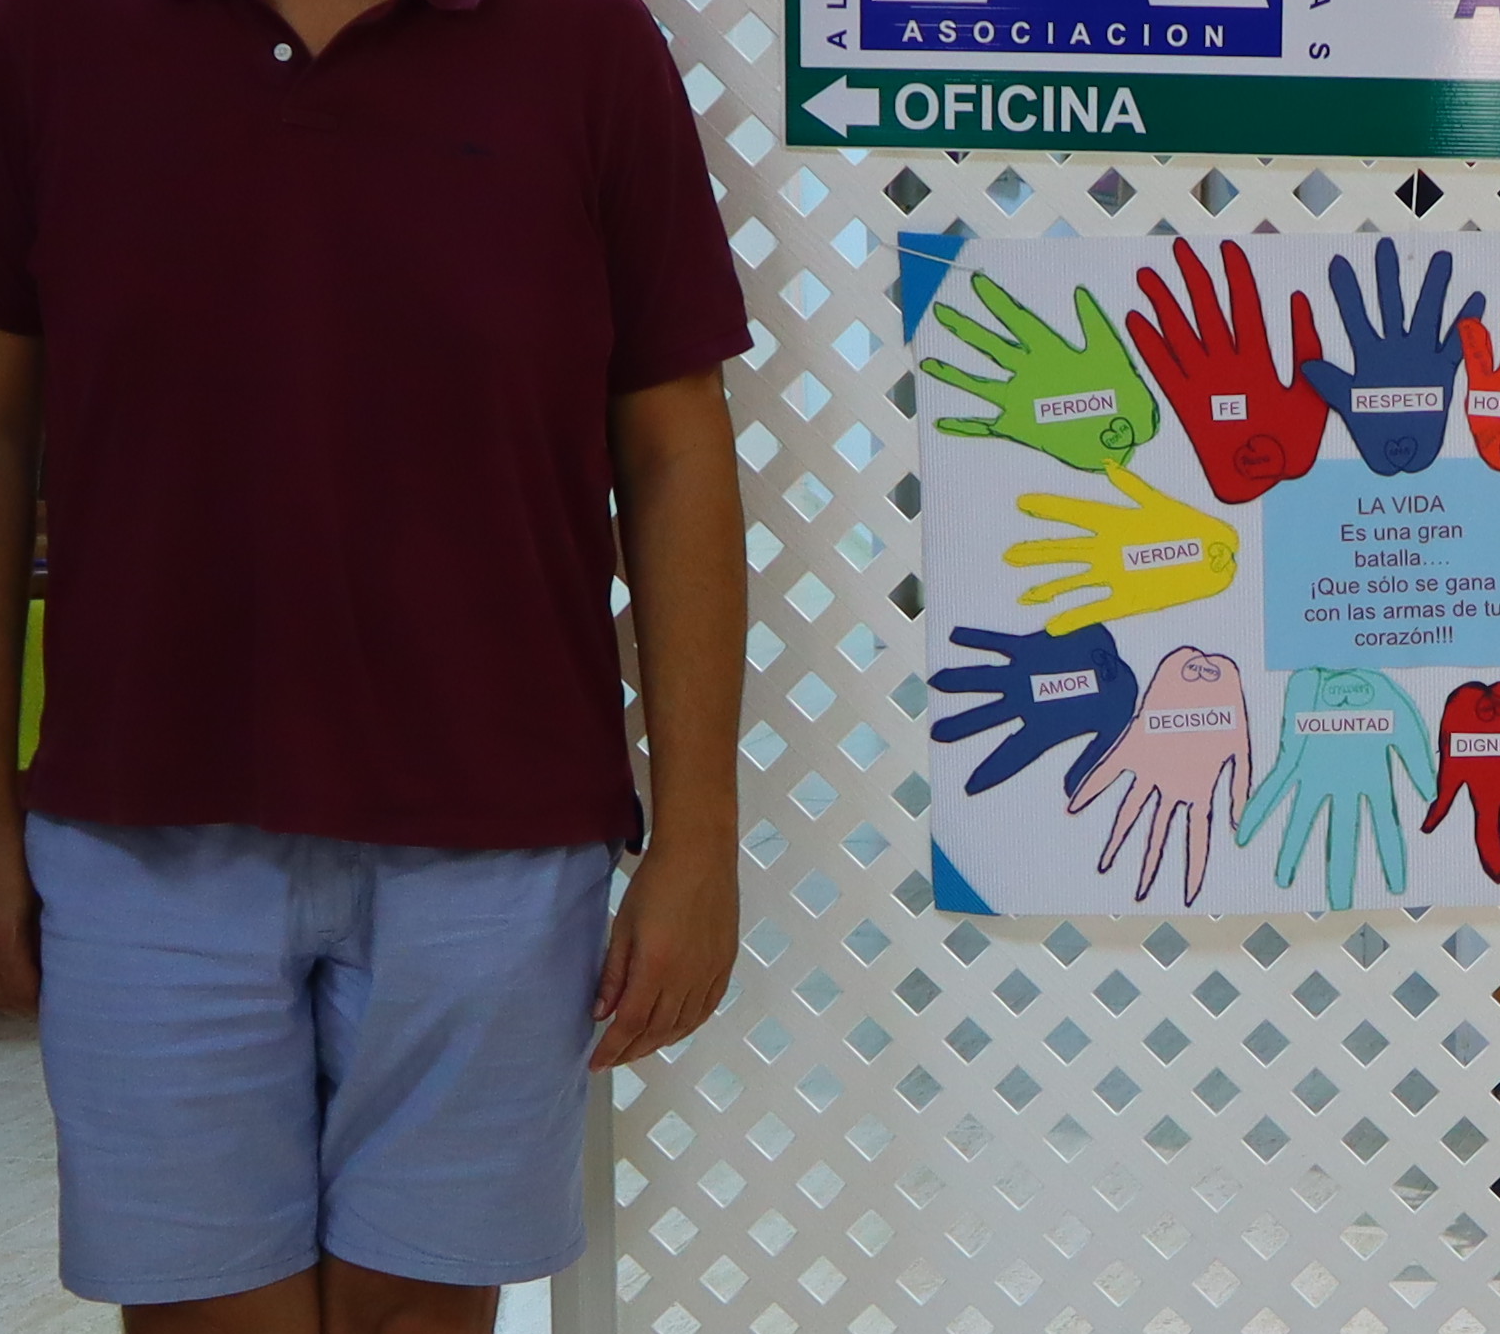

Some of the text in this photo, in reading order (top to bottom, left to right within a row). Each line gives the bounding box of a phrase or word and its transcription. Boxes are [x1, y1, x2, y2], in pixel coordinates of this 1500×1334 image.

[903, 19, 1228, 48] ASOCIACION
[893, 83, 1147, 137] OFICINA
[1039, 394, 1113, 418] PERDÓN
[1219, 401, 1241, 416] FE
[1356, 392, 1438, 409] RESPETO
[1357, 494, 1445, 515] LA VIDA
[1340, 524, 1463, 543] Es una gran
[1128, 543, 1200, 566] VERDAD
[1310, 576, 1496, 600] ¡Que sólo se gana
[1304, 607, 1340, 622] con
[1348, 603, 1376, 620] las
[1383, 603, 1445, 619] armas
[1452, 600, 1477, 617] de
[1354, 626, 1454, 646] corazón!!!
[1038, 675, 1090, 695] AMOR
[1149, 709, 1232, 730] DECISIÓN
[1297, 718, 1389, 732] VOLUNTAD
